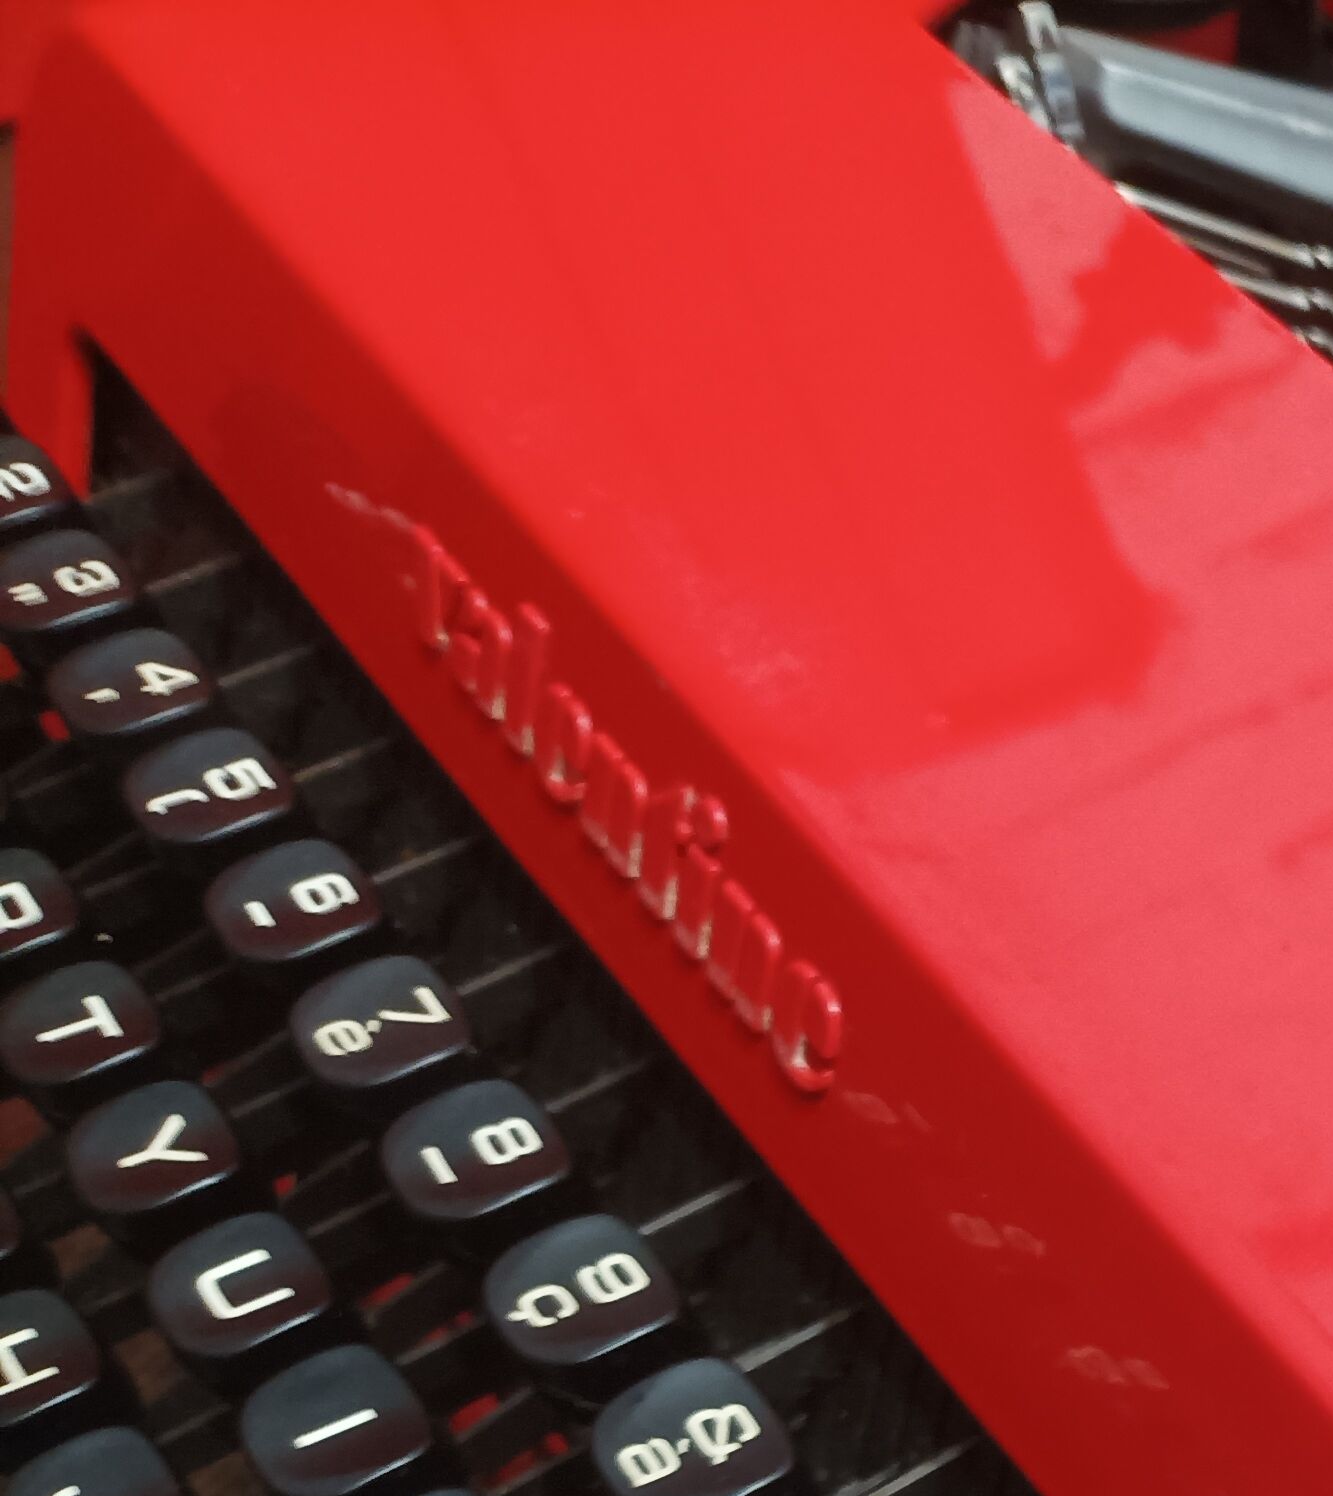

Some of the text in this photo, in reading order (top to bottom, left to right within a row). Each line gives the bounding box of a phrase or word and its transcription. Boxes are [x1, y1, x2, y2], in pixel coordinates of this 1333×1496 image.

[0, 462, 50, 500] 2
[53, 560, 120, 597] 3
[135, 661, 198, 695] 4
[203, 758, 277, 802] 5
[290, 874, 357, 913] 6
[37, 996, 122, 1041] T
[379, 988, 449, 1022] 7
[119, 1115, 206, 1167] Y
[472, 1118, 541, 1164] 8
[196, 1249, 296, 1319] U
[577, 1253, 650, 1304] 9
[508, 1285, 578, 1326] ç
[294, 1410, 377, 1448] I
